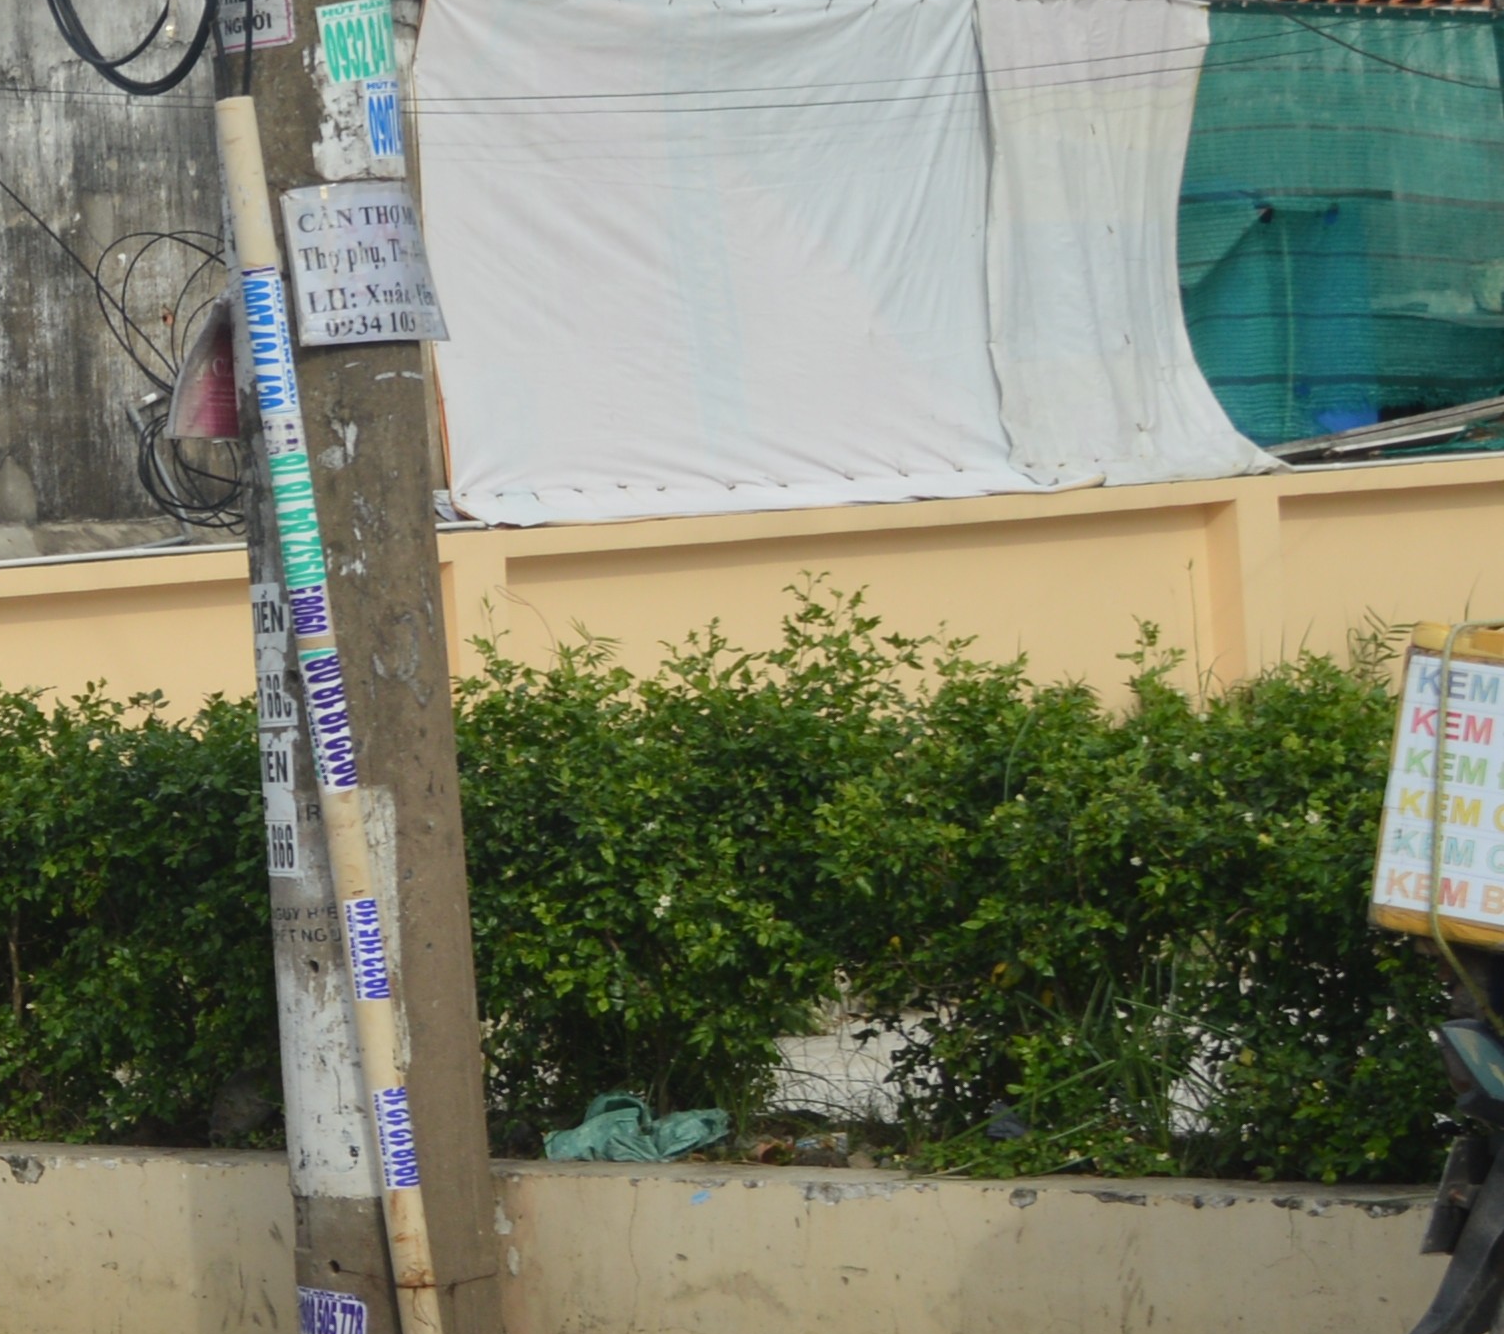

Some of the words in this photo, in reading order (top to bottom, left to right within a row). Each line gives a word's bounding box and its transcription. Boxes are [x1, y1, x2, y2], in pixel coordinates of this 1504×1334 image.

[297, 204, 354, 234] CẦN
[299, 246, 340, 274] Thợ
[1417, 667, 1501, 705] KEM
[1410, 706, 1494, 745] KEM
[1385, 868, 1469, 908] KEM
